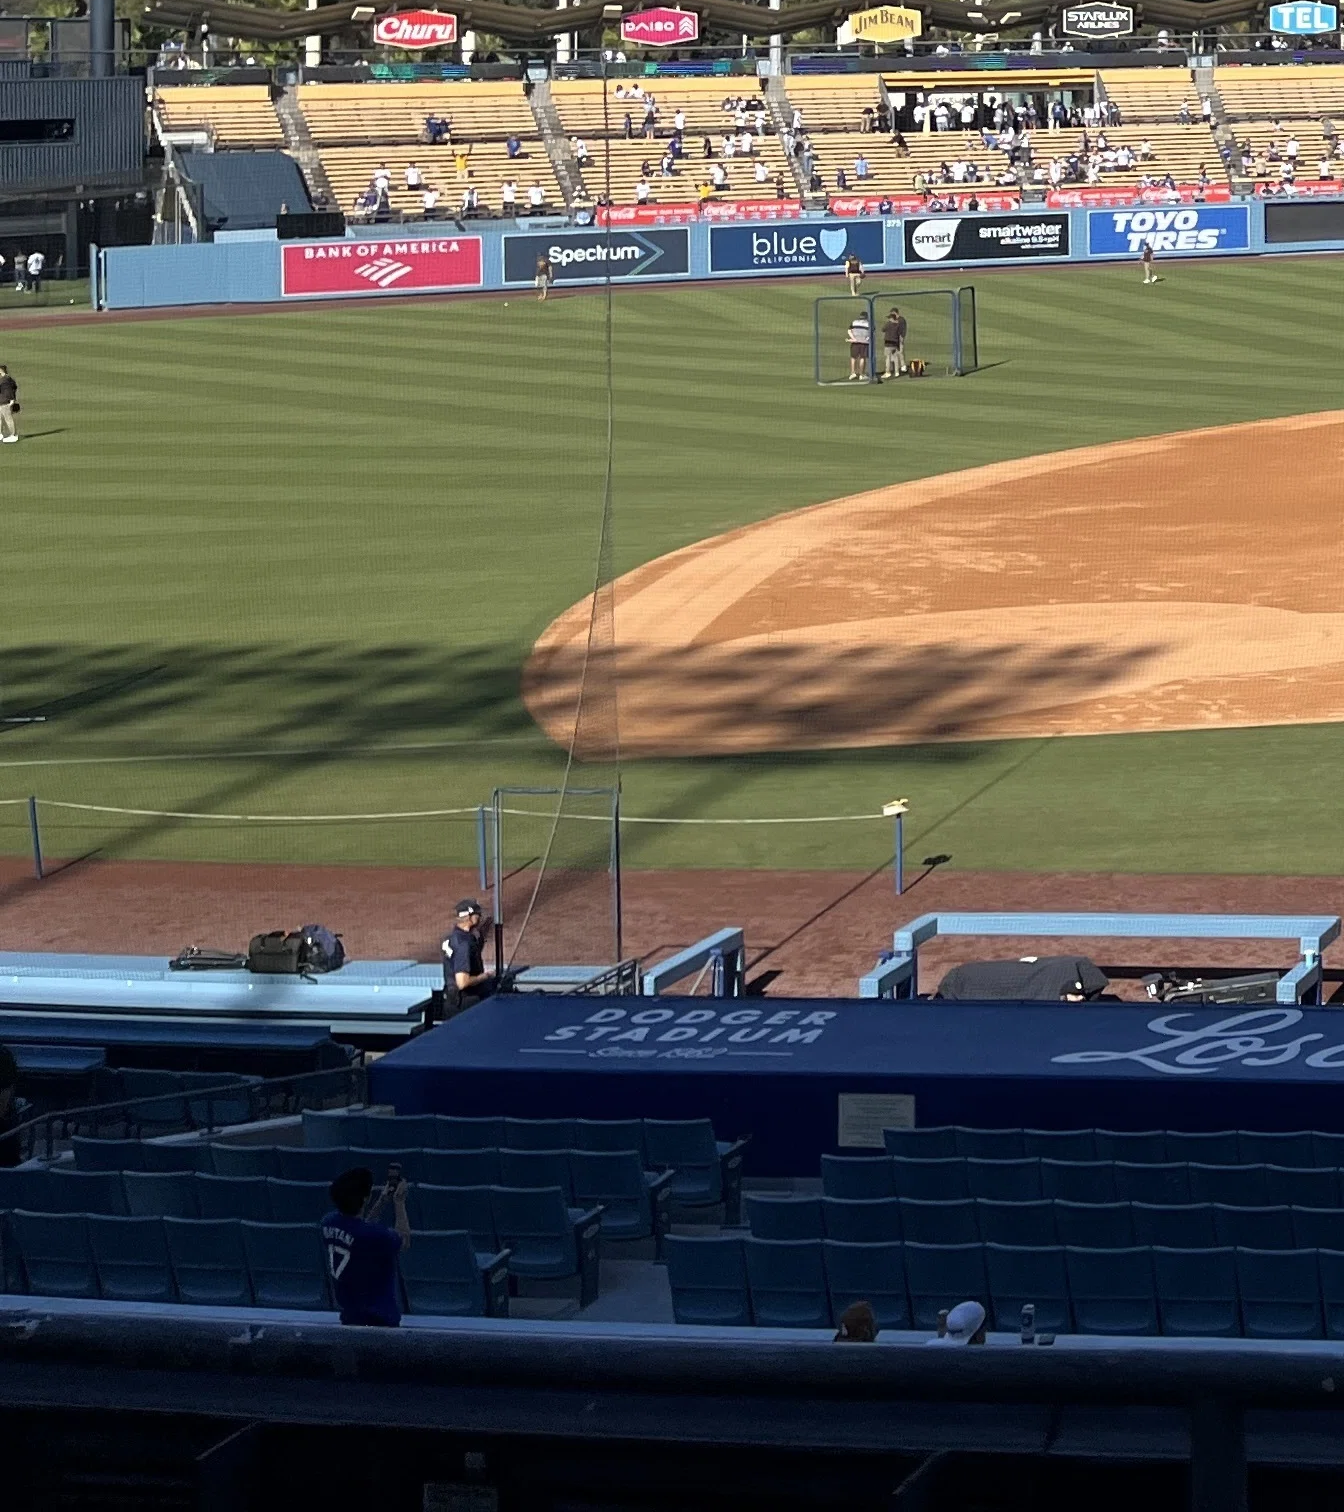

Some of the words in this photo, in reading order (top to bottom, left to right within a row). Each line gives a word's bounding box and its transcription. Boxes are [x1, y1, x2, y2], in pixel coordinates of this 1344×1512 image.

[855, 15, 878, 35] JIM
[880, 9, 915, 34] BEAM
[1066, 10, 1129, 22] STARLUX
[1076, 21, 1120, 29] AIRLINES
[1277, 6, 1331, 30] TEL
[377, 17, 453, 41] Churu
[625, 21, 675, 32] DAISO
[979, 223, 1062, 238] smartwater
[1113, 210, 1198, 232] TOYO
[753, 232, 816, 256] blue
[914, 232, 952, 245] smart
[1127, 228, 1220, 252] TIRES
[304, 245, 352, 259] BANK
[357, 243, 378, 257] OF
[383, 240, 460, 256] AMERICA
[548, 245, 641, 267] Spectrum
[753, 256, 817, 265] CALIFORNIA
[584, 1007, 838, 1026] DODGER
[543, 1024, 824, 1044] STADIUM
[1051, 1008, 1325, 1074] Los
